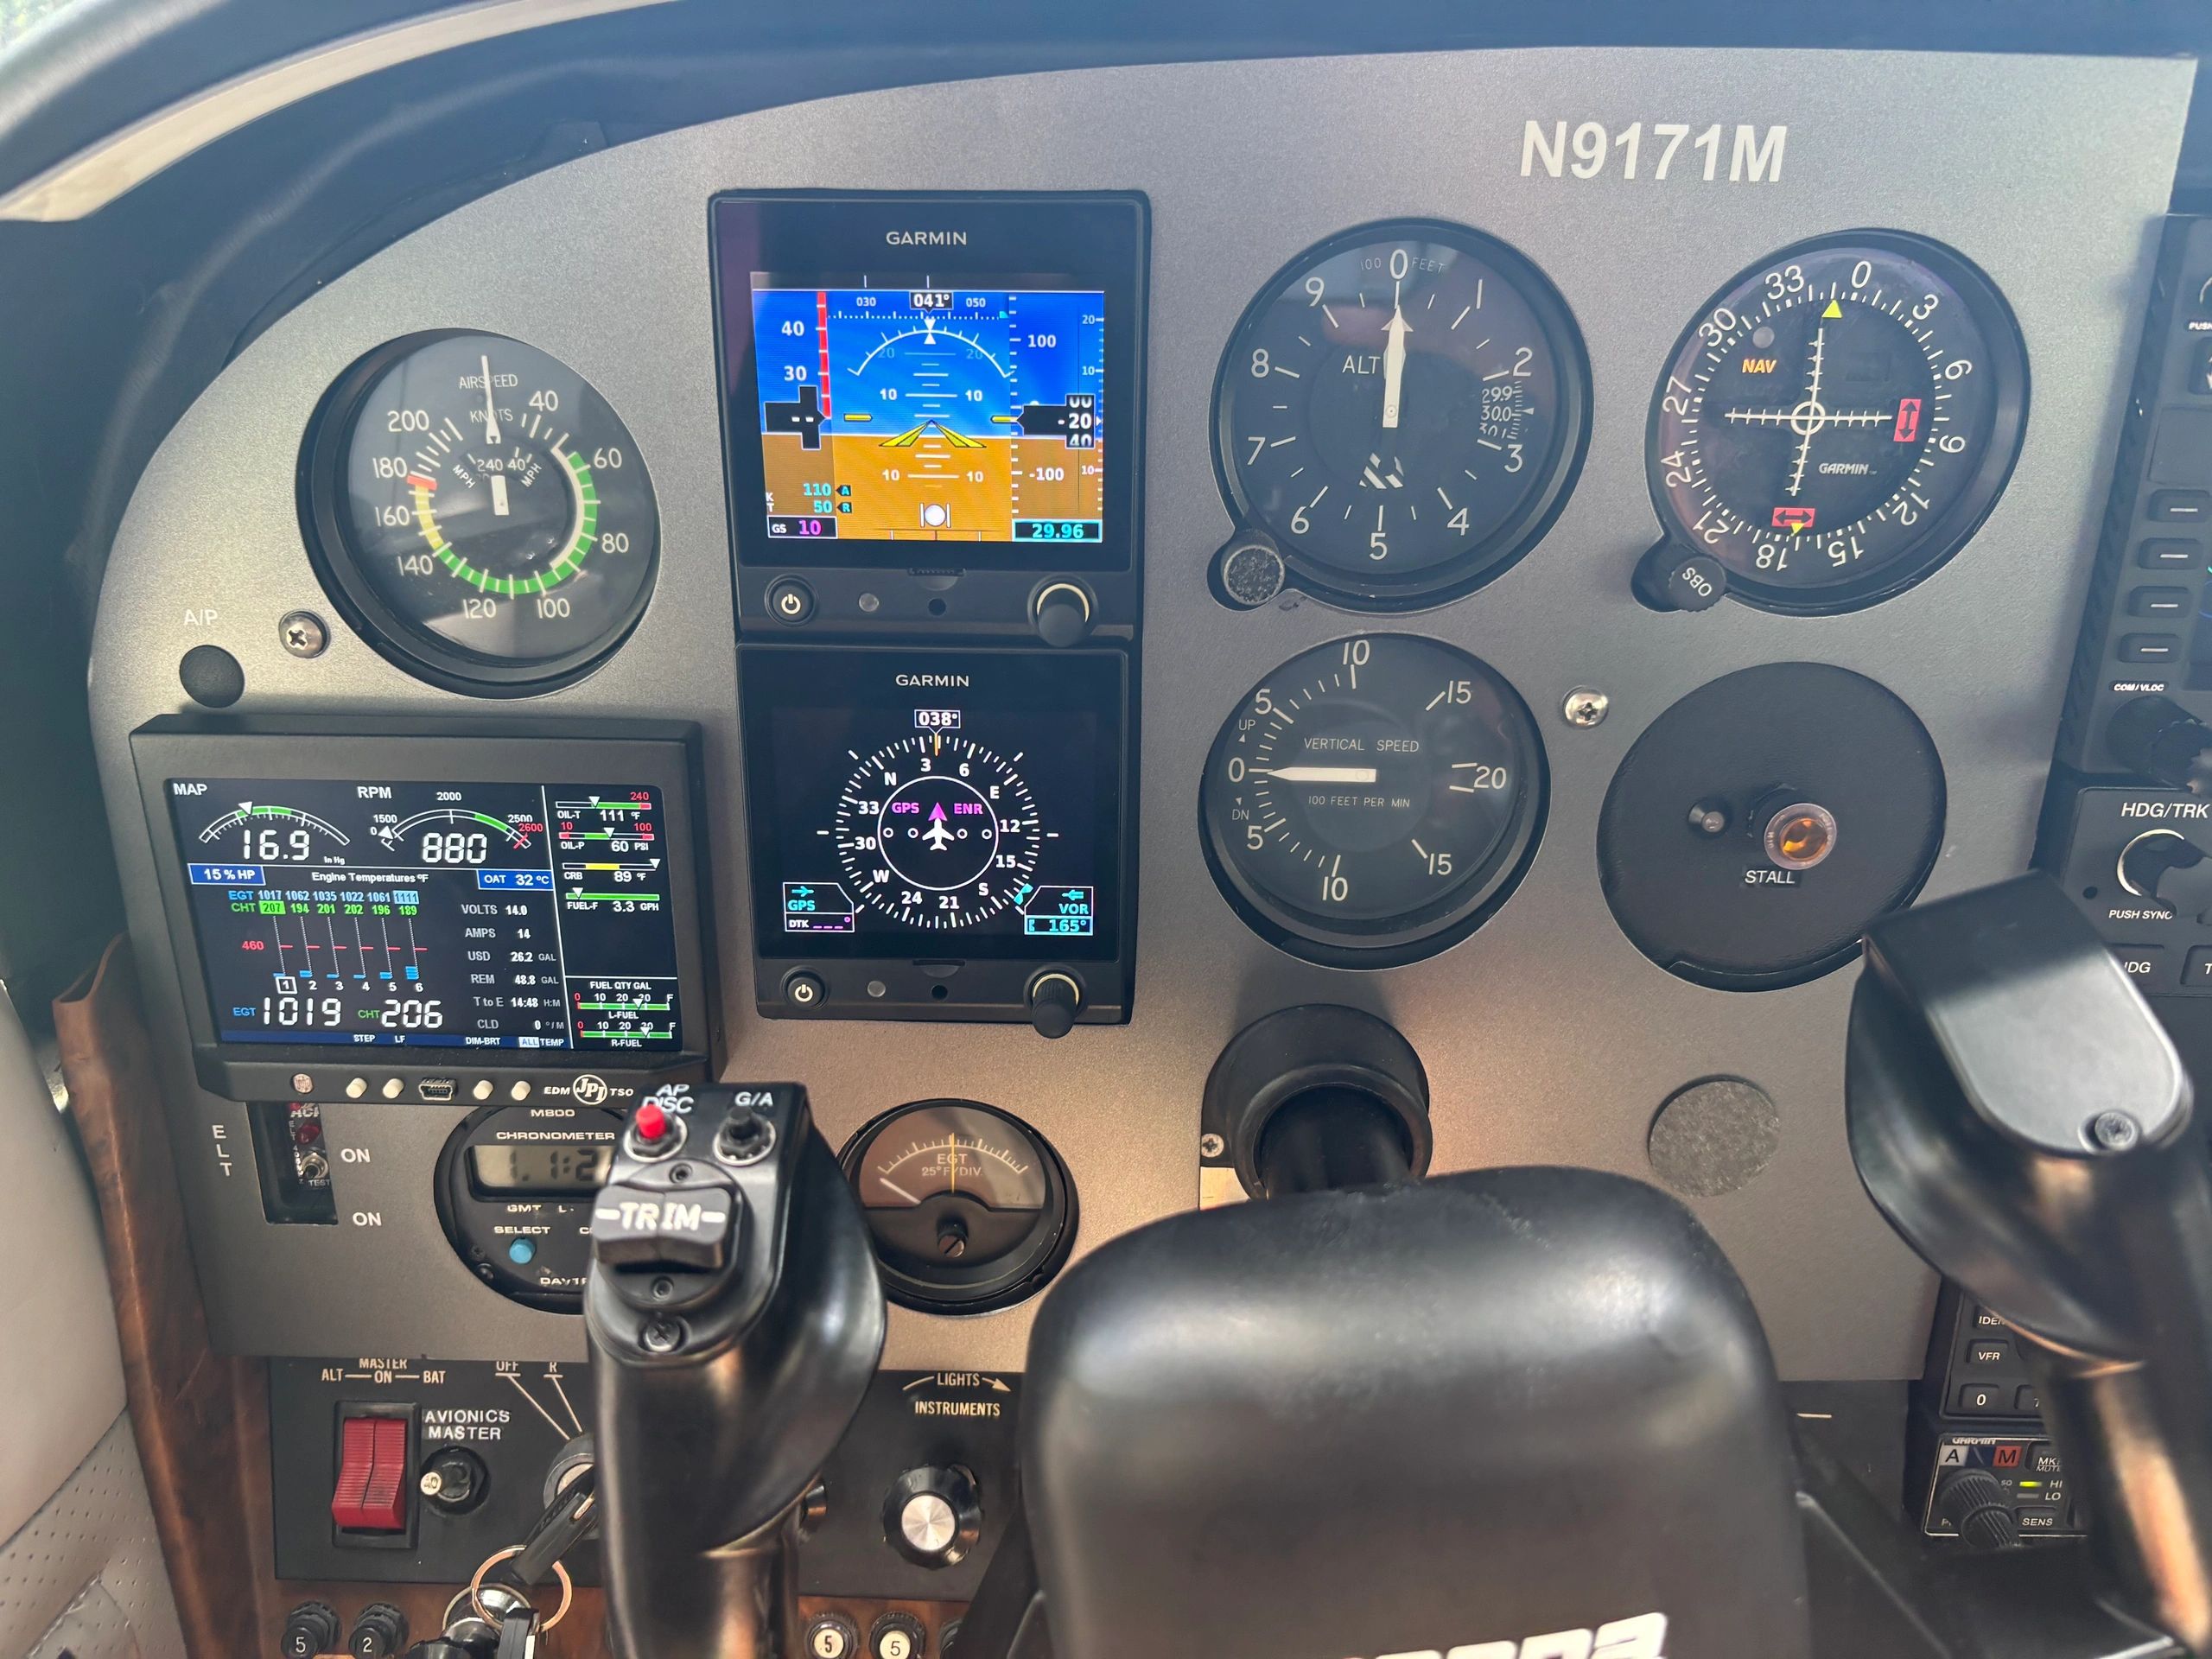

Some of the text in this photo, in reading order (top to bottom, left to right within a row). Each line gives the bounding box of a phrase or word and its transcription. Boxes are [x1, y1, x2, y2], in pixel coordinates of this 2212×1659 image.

[1520, 119, 1788, 182] N9171M
[886, 231, 967, 246] GARMIN
[1389, 249, 1408, 280] 0
[1412, 257, 1446, 273] FEET
[1764, 264, 1804, 300] 33
[1851, 261, 1872, 289] 0
[1305, 276, 1325, 307] 9
[856, 296, 876, 307] 030
[965, 297, 986, 308] 050
[1913, 294, 1939, 321] 3
[781, 321, 804, 336] 40
[1698, 308, 1737, 348] 30
[1027, 334, 1057, 348] 100
[1251, 348, 1269, 378] 8
[1342, 355, 1381, 375] ALT
[1513, 347, 1534, 377] 2
[1742, 359, 1777, 373] NAV
[784, 365, 807, 381] 30
[529, 391, 559, 411] 40
[1482, 385, 1513, 404] 29.9
[1662, 376, 1693, 413] 27
[387, 410, 430, 433] 200
[1481, 404, 1512, 423] 30.0
[594, 448, 623, 468] 60
[1248, 436, 1266, 465] 7
[1503, 443, 1523, 473] 3
[372, 457, 408, 478] 180
[477, 458, 503, 474] 240
[1661, 450, 1693, 487] 24
[1818, 462, 1869, 475] GARMIN
[453, 464, 476, 489] MPH
[520, 462, 543, 488] MPH
[803, 483, 832, 496] 110
[814, 500, 833, 513] 50
[1892, 493, 1930, 525] 12
[375, 505, 410, 527] 160
[1290, 505, 1310, 534] 6
[1447, 507, 1469, 536] 4
[772, 519, 822, 535] GS 10
[1031, 524, 1084, 539] 29.96
[1692, 511, 1730, 544] 21
[602, 532, 630, 554] 80
[1370, 532, 1388, 560] 5
[1755, 543, 1789, 571] 18
[1827, 536, 1864, 567] 15
[397, 555, 433, 575] 140
[1681, 566, 1712, 597] OBS
[463, 598, 497, 620] 120
[537, 598, 570, 619] 100
[183, 609, 218, 626] A/P
[1343, 639, 1370, 665] 10
[895, 674, 969, 688] GARMIN
[1446, 680, 1472, 703] 15
[1255, 689, 1272, 715] 5
[918, 712, 958, 727] 038°
[1238, 719, 1255, 732] UP
[1304, 737, 1420, 753] VERTICAL SPEED
[1228, 756, 1245, 783] 0
[1473, 766, 1507, 790] 20
[174, 783, 207, 796] MAP
[357, 786, 392, 799] RPM
[436, 791, 462, 801] 2000
[859, 801, 880, 815] 33
[891, 802, 983, 815] GPS ENR
[1308, 795, 1411, 809] 100 FEET PER MIN
[2121, 802, 2211, 818] HDG/TRK
[372, 814, 397, 823] 1500
[600, 810, 625, 821] 111
[1231, 809, 1249, 821] DN
[1000, 819, 1020, 832] 12
[855, 836, 876, 850] 30
[1247, 824, 1263, 850] 5
[243, 830, 309, 861] 16.9
[423, 833, 487, 863] 880
[611, 840, 629, 852] 60
[995, 855, 1016, 868] 15
[1428, 853, 1452, 875] 15
[204, 868, 256, 880] 15 HP
[312, 872, 416, 883] Engine Temperatures
[484, 874, 534, 886] OAT 32
[1745, 869, 1796, 885] STALL
[1322, 876, 1349, 901] 10
[612, 900, 635, 912] 3.3
[787, 899, 816, 912] GPS
[901, 891, 923, 905] 24
[938, 895, 960, 909] 21
[461, 904, 528, 916] VOLTS 14.0
[1058, 903, 1089, 915] VOR
[2108, 910, 2172, 920] PUSH SYNC
[789, 919, 810, 928] DTK
[465, 928, 531, 939] AMPS 14
[589, 981, 652, 990] FUEL QTY GAL
[232, 996, 342, 1027] EGT 1019
[358, 999, 443, 1029] CHT 206
[543, 1086, 570, 1095] EDM
[610, 1087, 634, 1096] TSO
[655, 1084, 690, 1096] AP
[735, 1091, 774, 1106] G/A
[531, 1109, 575, 1117] M800
[496, 1131, 615, 1141] CHRONOMETER
[340, 1148, 371, 1163] ON
[937, 1154, 969, 1165] EGT
[353, 1211, 382, 1226] ON
[619, 1202, 702, 1231] TRIM
[493, 1225, 551, 1235] SELECT
[359, 1357, 408, 1370] MASTER
[1978, 1351, 2001, 1361] VFR
[321, 1368, 447, 1384] ALT ON BAT
[937, 1372, 981, 1387] LIGHTS
[424, 1408, 511, 1424] AVIONICS
[914, 1401, 1001, 1417] INSTRUMENTS
[428, 1426, 502, 1440] MASTER
[1945, 1448, 1960, 1463] A
[1998, 1448, 2018, 1464] M
[2050, 1479, 2063, 1489] HI
[2044, 1492, 2062, 1501] LO
[2022, 1517, 2053, 1527] SENS
[295, 1637, 306, 1654] 5
[362, 1637, 373, 1653] 2
[824, 1635, 833, 1653] 5
[890, 1641, 901, 1656] 5
